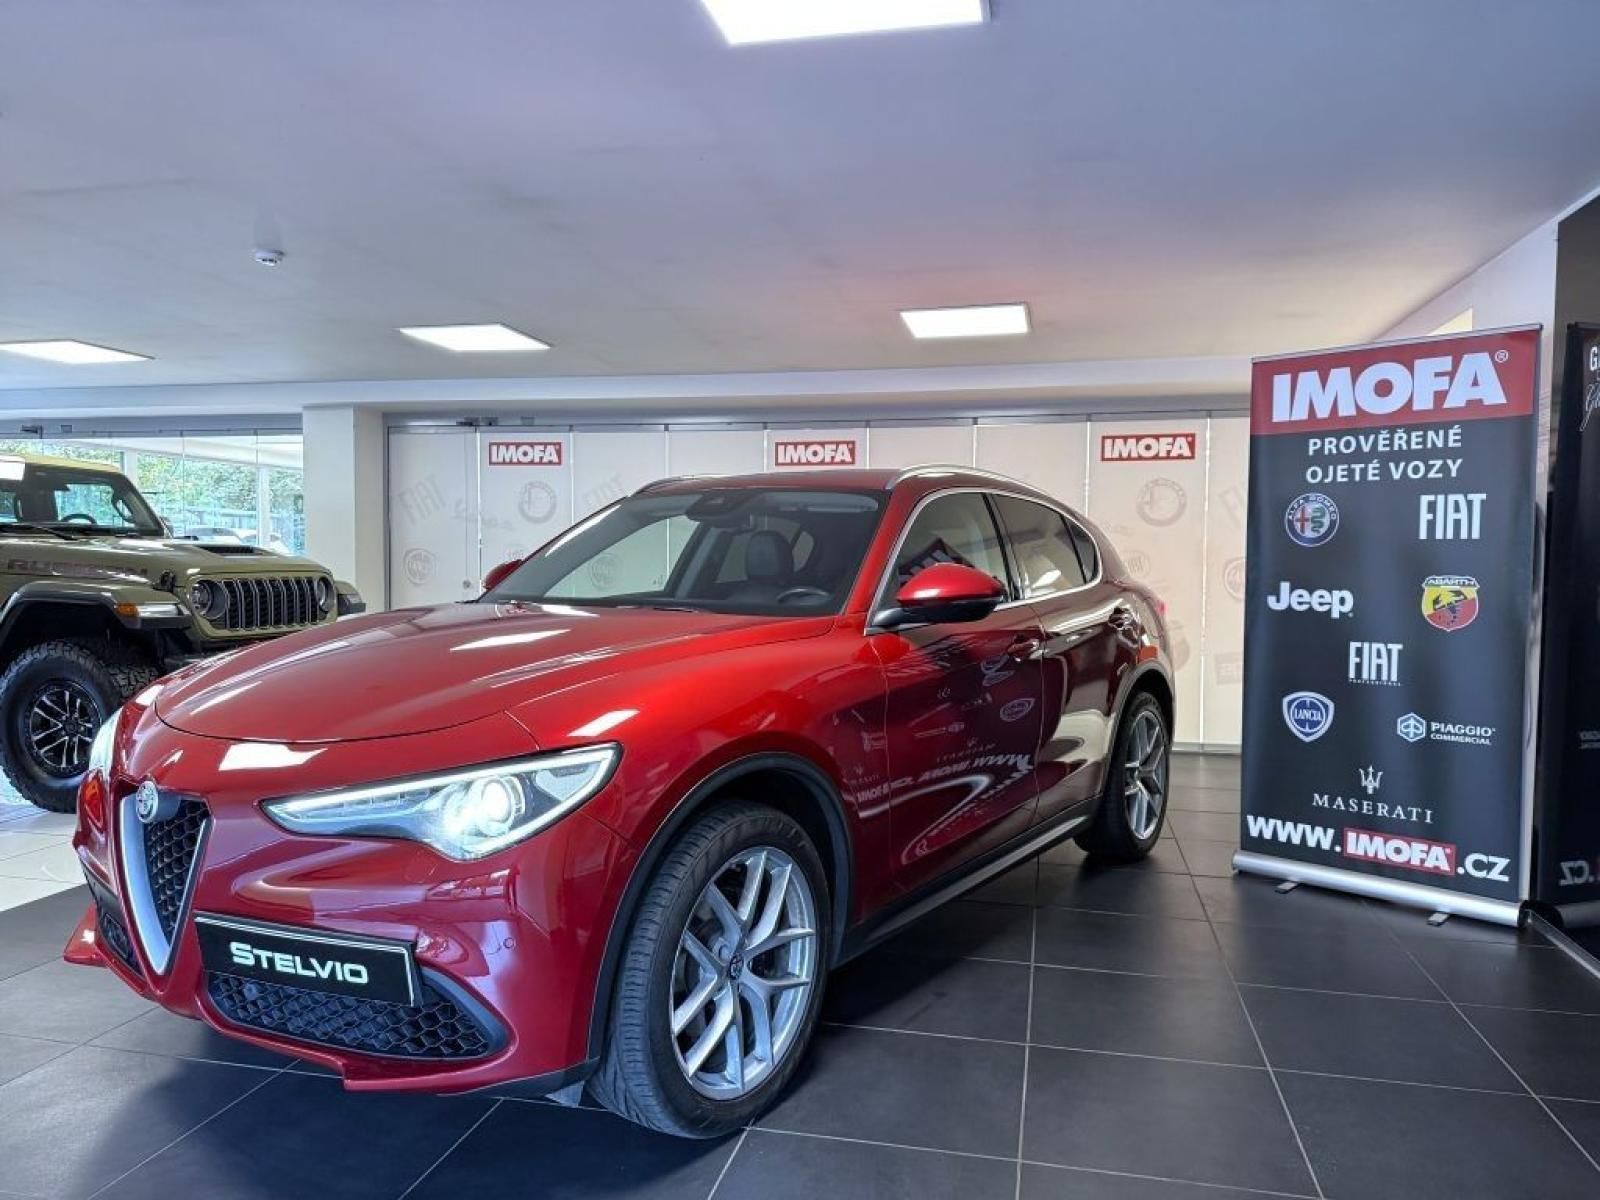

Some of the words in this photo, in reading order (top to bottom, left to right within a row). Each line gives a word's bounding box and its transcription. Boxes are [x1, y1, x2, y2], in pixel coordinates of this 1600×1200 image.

[490, 444, 559, 463] IMOFA
[777, 444, 853, 465] IMOFA
[1103, 437, 1192, 458] IMOFA
[1308, 425, 1463, 456] PROVĚŘENÉ
[1305, 459, 1381, 484] OJETÉ
[1389, 458, 1463, 482] VOZY
[1418, 493, 1487, 540] FIAT
[1267, 581, 1354, 619] Jeep
[1349, 641, 1403, 681] FIAT
[1430, 721, 1493, 737] PIAGGIO
[1430, 733, 1491, 745] COMMERCIAL
[1312, 793, 1435, 824] MASERATI
[229, 941, 369, 984] STELVIO
